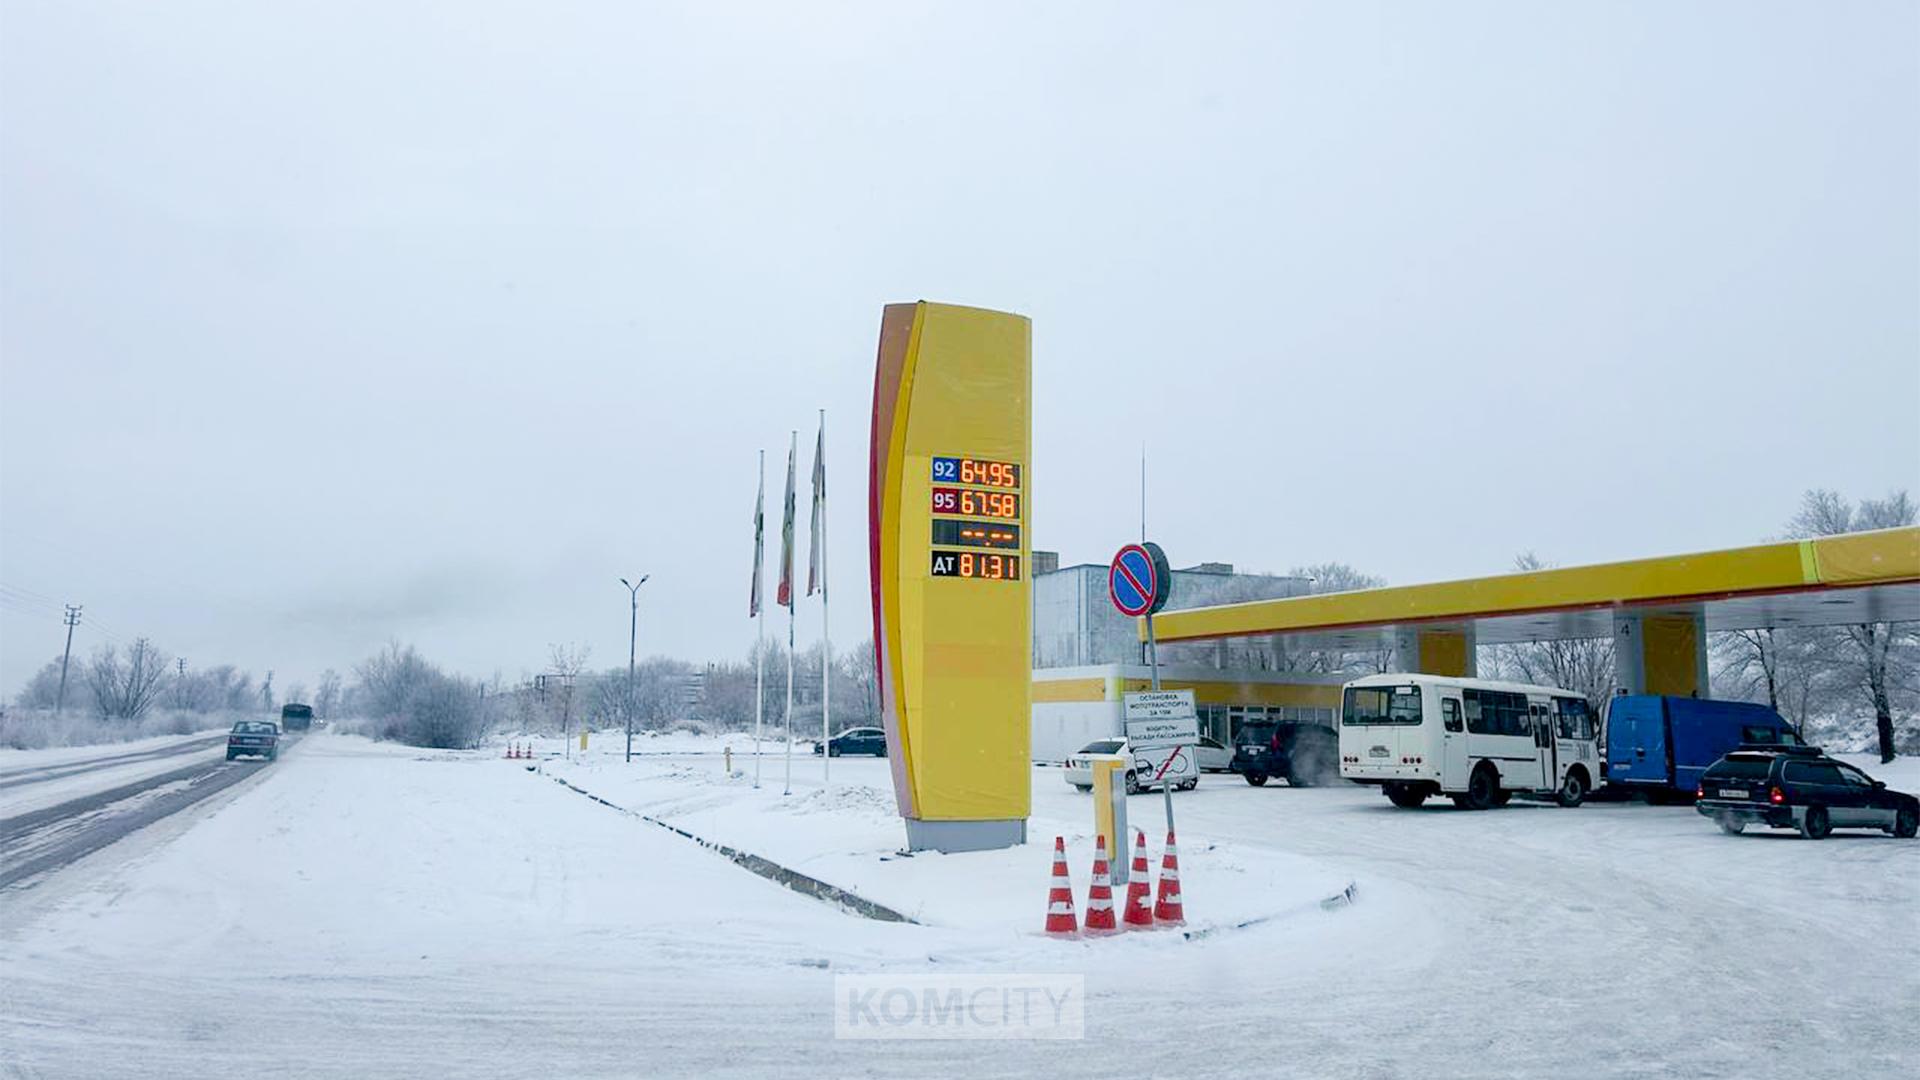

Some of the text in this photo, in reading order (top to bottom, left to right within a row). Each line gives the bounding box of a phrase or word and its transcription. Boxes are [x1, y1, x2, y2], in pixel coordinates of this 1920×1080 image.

[934, 460, 1014, 487] 92 64.95
[934, 491, 1014, 517] 95 67.58
[933, 554, 1014, 579] ДТ 81.31
[1140, 694, 1178, 702] ОСТАНОВКА
